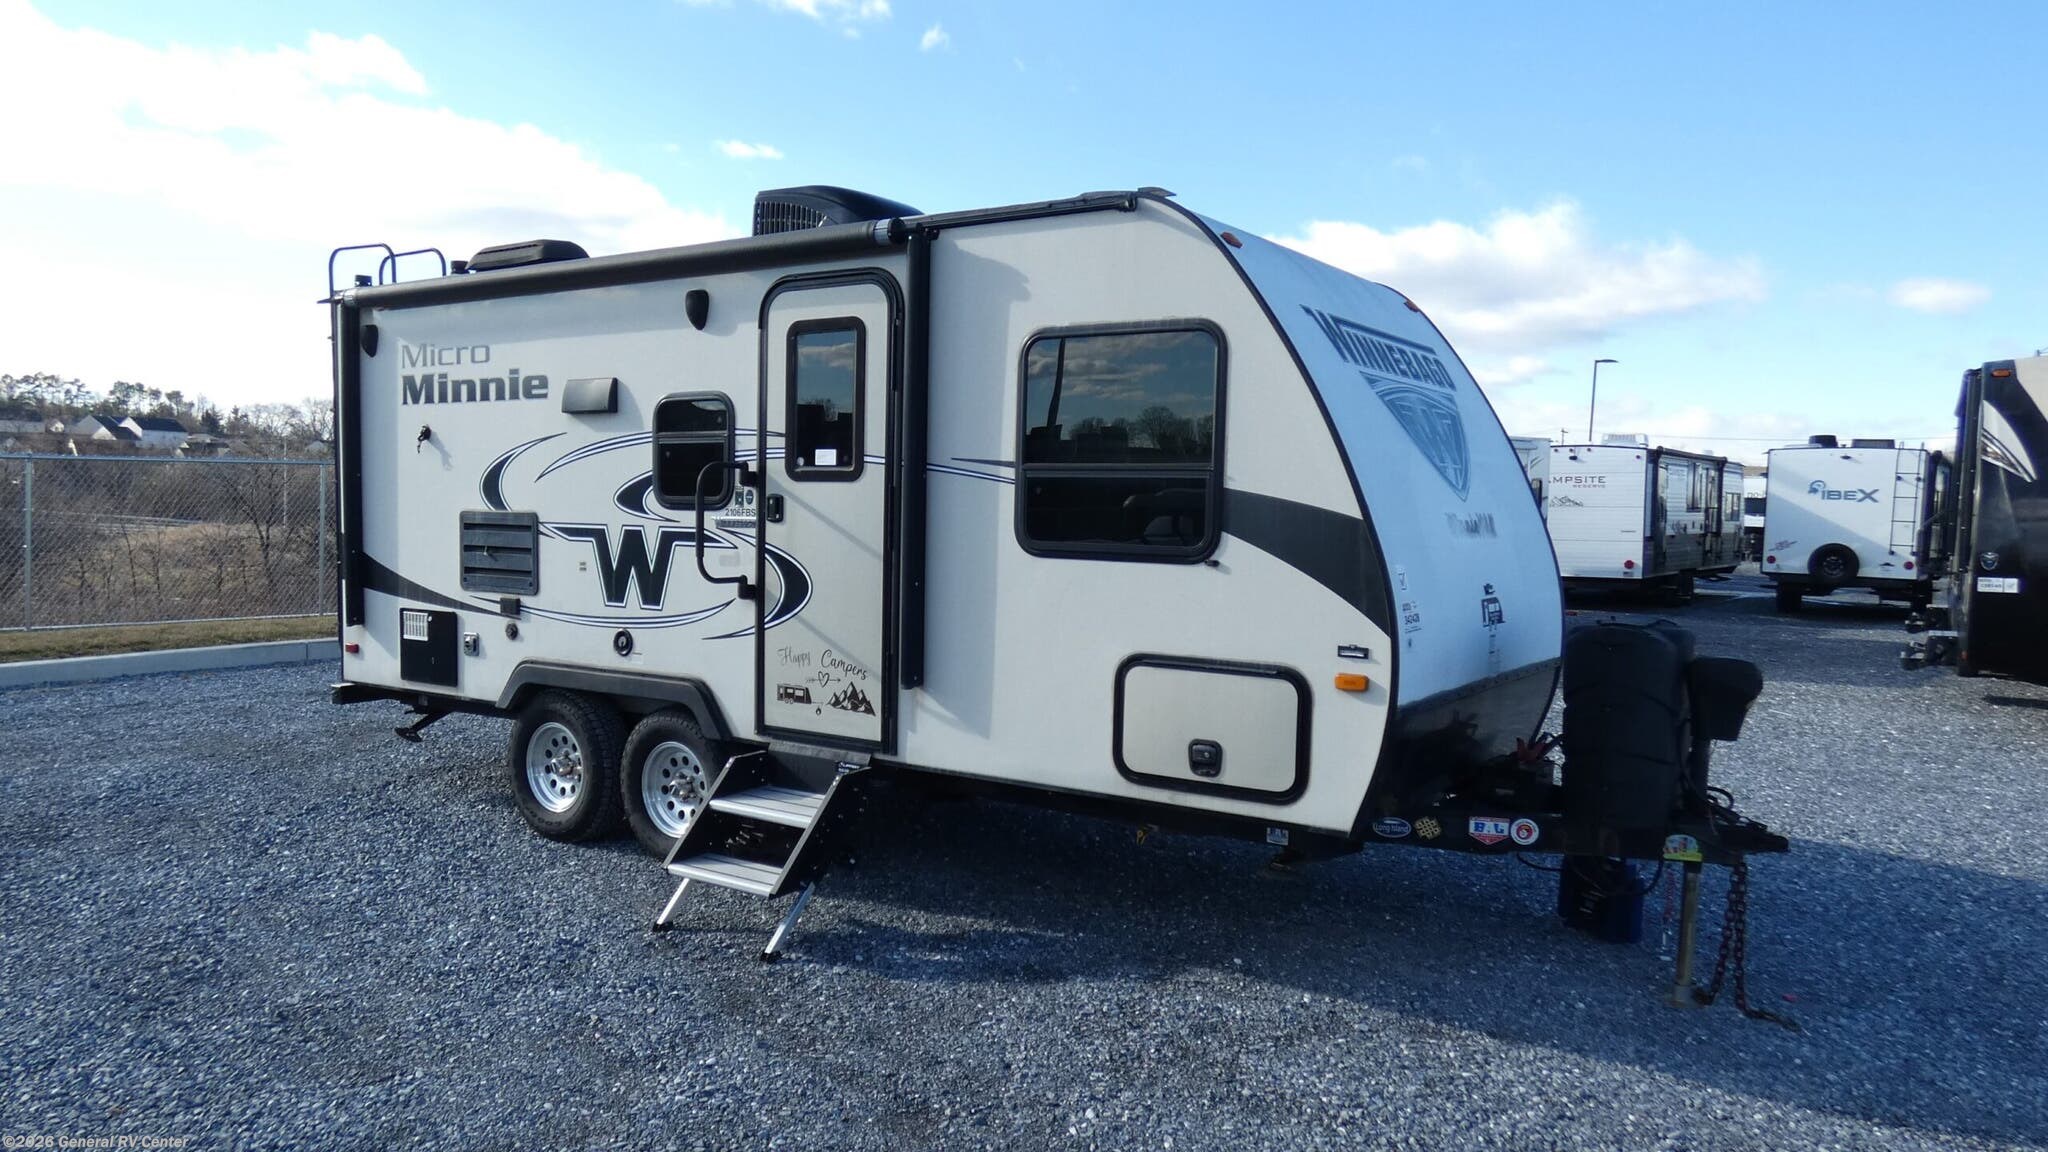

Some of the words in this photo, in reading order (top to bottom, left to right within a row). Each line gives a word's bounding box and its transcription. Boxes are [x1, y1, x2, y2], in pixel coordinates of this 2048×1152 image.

[402, 343, 490, 369] Micro
[1299, 303, 1456, 391] WINNEBAGO
[402, 368, 549, 405] Minnie
[1548, 475, 1606, 484] MPSITE
[725, 507, 756, 517] 2106FBS
[777, 646, 811, 668] Happy
[820, 649, 868, 681] Campers
